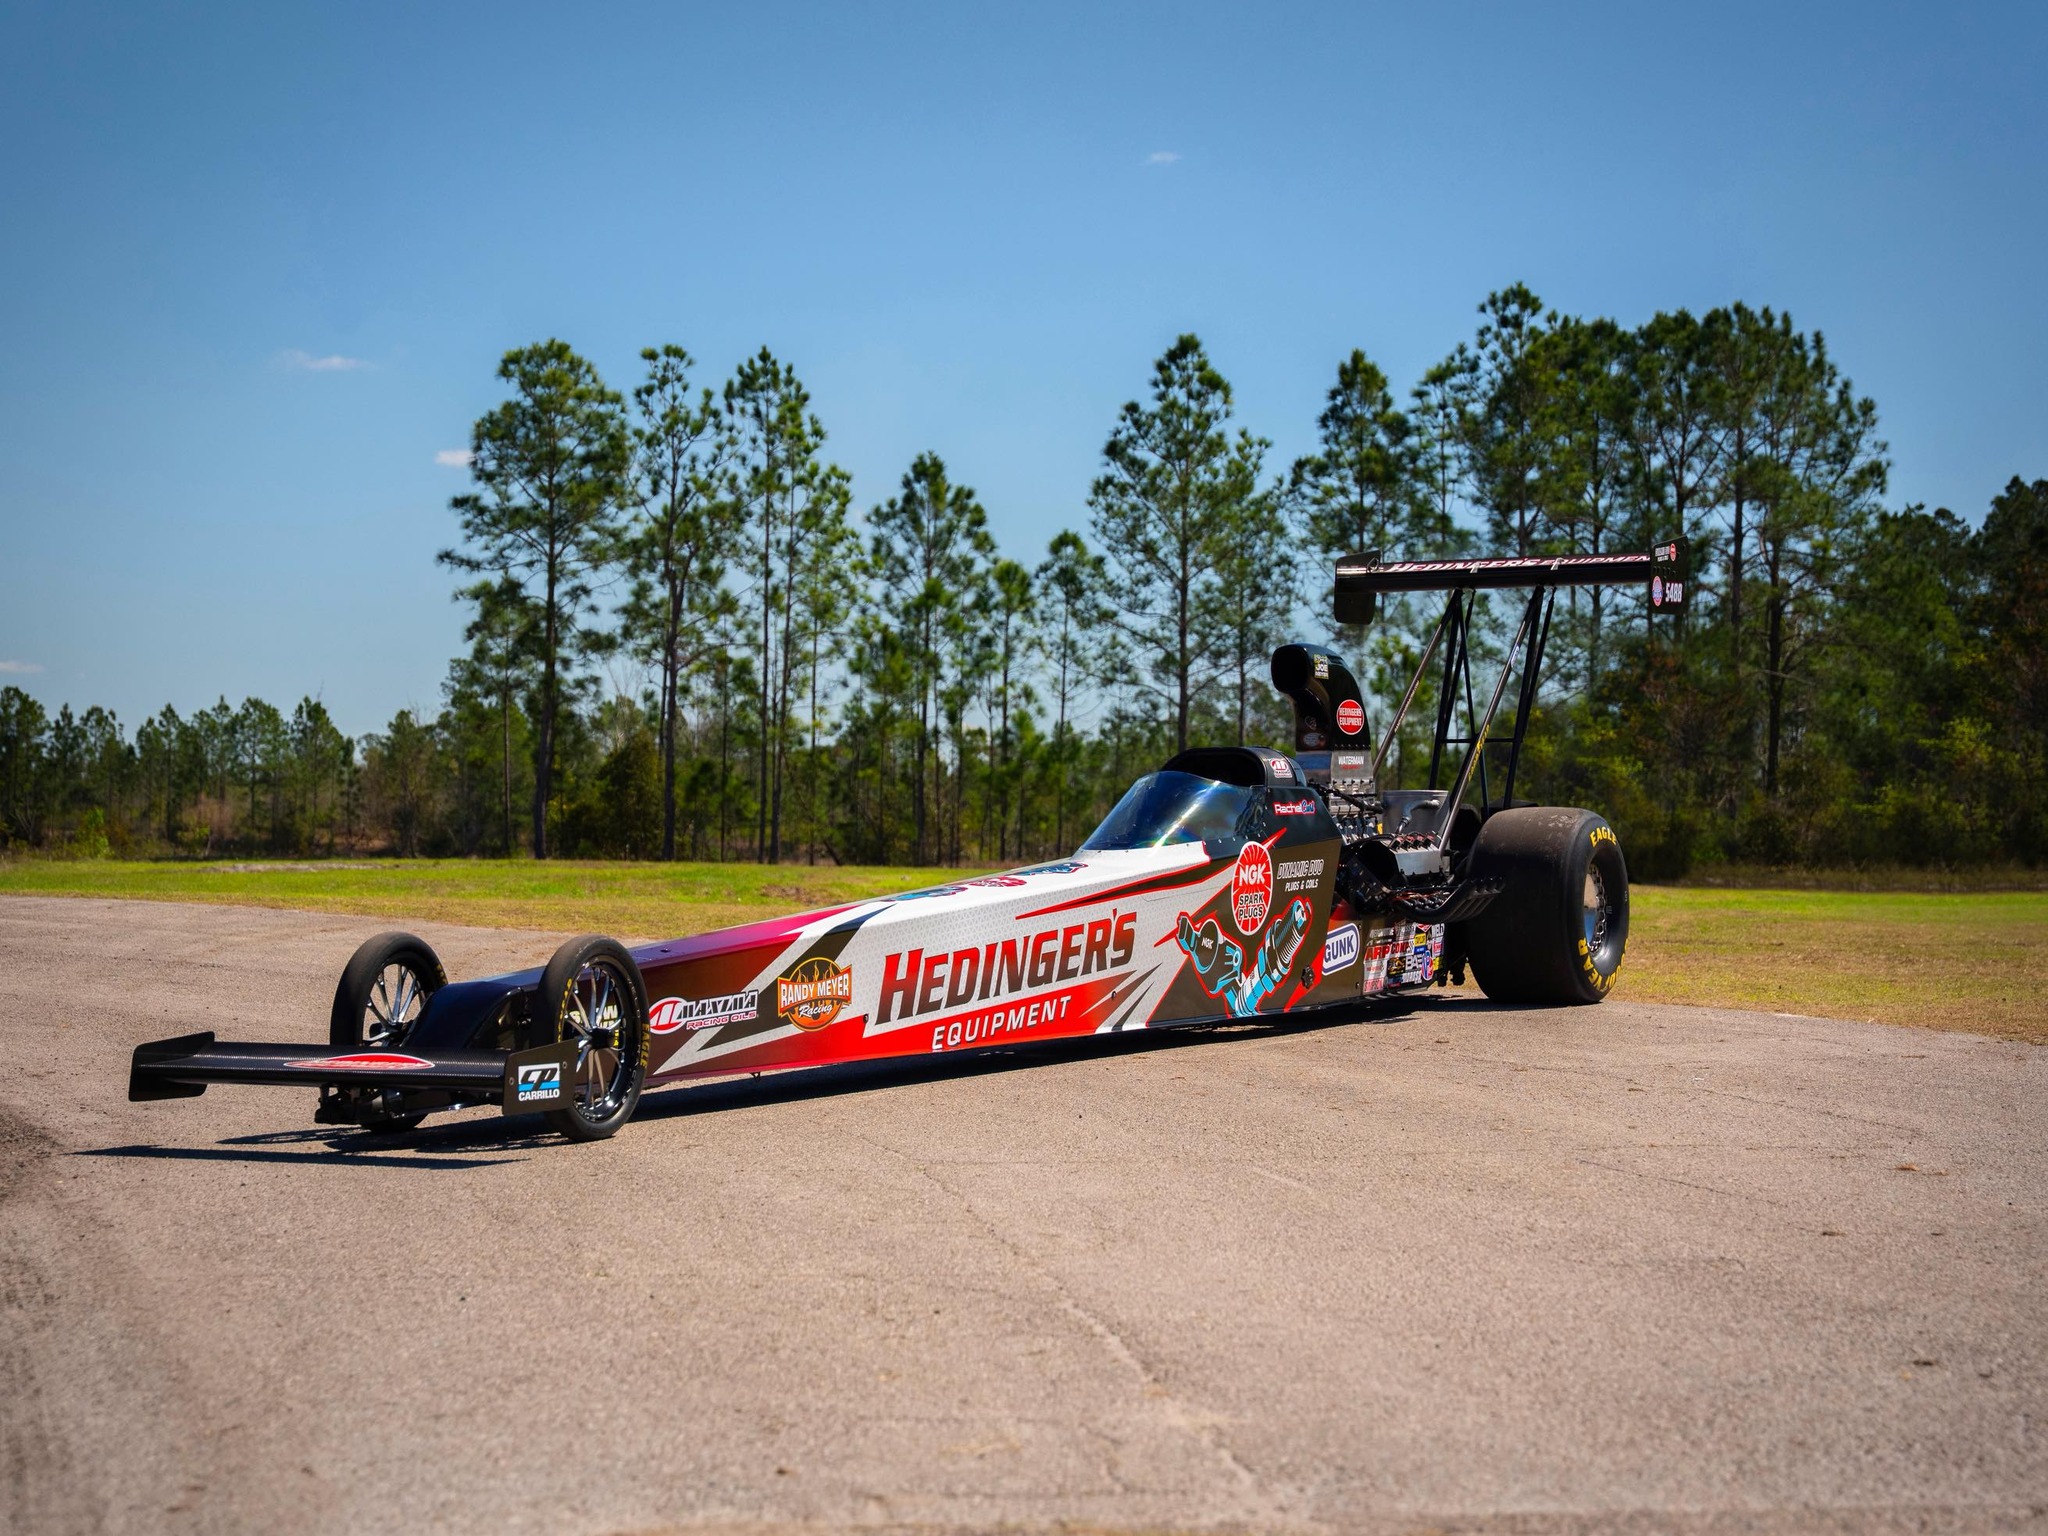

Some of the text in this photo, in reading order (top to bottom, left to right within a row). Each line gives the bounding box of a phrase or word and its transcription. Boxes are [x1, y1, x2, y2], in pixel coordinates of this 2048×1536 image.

[1665, 582, 1683, 602] 5488
[1589, 826, 1617, 847] EAGLE
[1238, 863, 1266, 886] NGK
[1276, 859, 1325, 880] DYNAMIC DUO
[1284, 881, 1300, 892] PLUGS
[1305, 879, 1319, 889] COILS
[1238, 892, 1264, 906] SPARK
[1238, 906, 1264, 920] PLUGS
[1201, 937, 1214, 949] NGK
[1324, 935, 1355, 963] GUNK
[1364, 945, 1391, 960] ARP
[875, 908, 1137, 1026] HEDINGER'S
[780, 972, 850, 1008] RANDY MEYER
[677, 992, 757, 1019] MAXIMA
[798, 1004, 833, 1018] Racing
[731, 1011, 757, 1022] OILS
[931, 995, 1072, 1050] EQUIPMENT
[639, 1022, 650, 1069] EAGLE
[518, 1088, 560, 1102] CARRILLO
